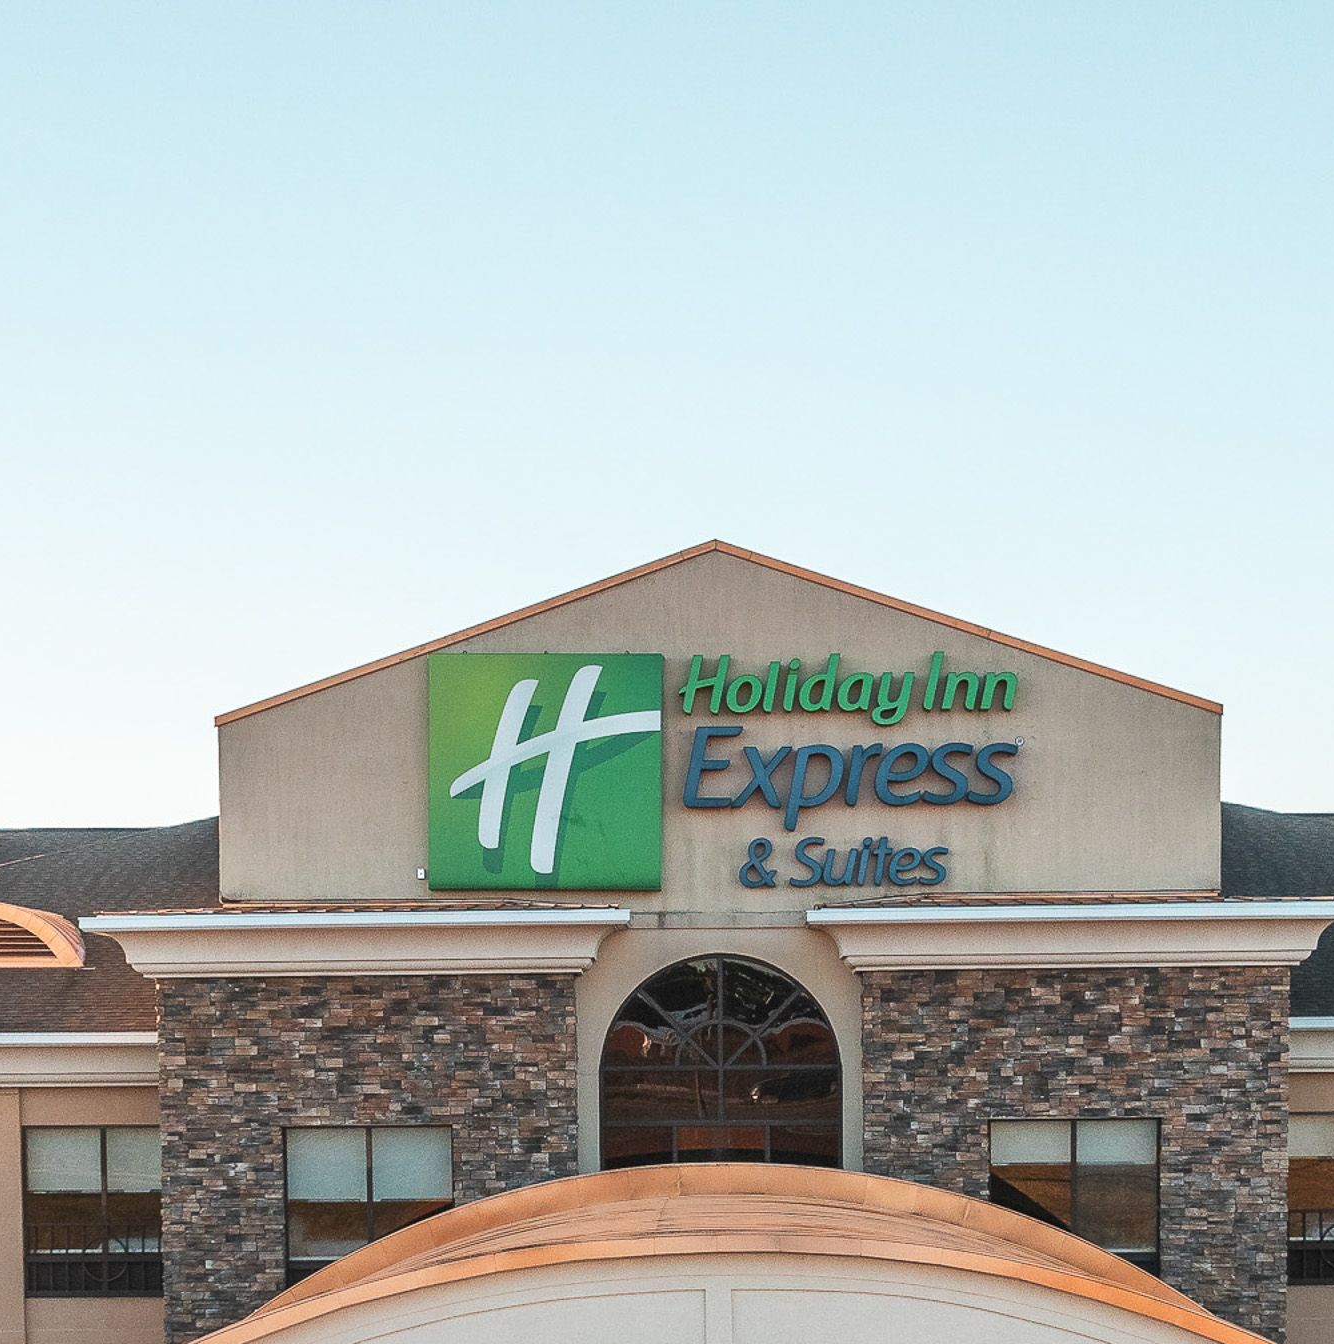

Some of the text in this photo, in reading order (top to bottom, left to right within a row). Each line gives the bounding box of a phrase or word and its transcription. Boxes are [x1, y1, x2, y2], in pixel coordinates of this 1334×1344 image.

[678, 651, 1018, 726] Holiday Inn
[450, 664, 661, 874] H
[682, 726, 1019, 831] Express
[738, 836, 949, 888] & Suites
